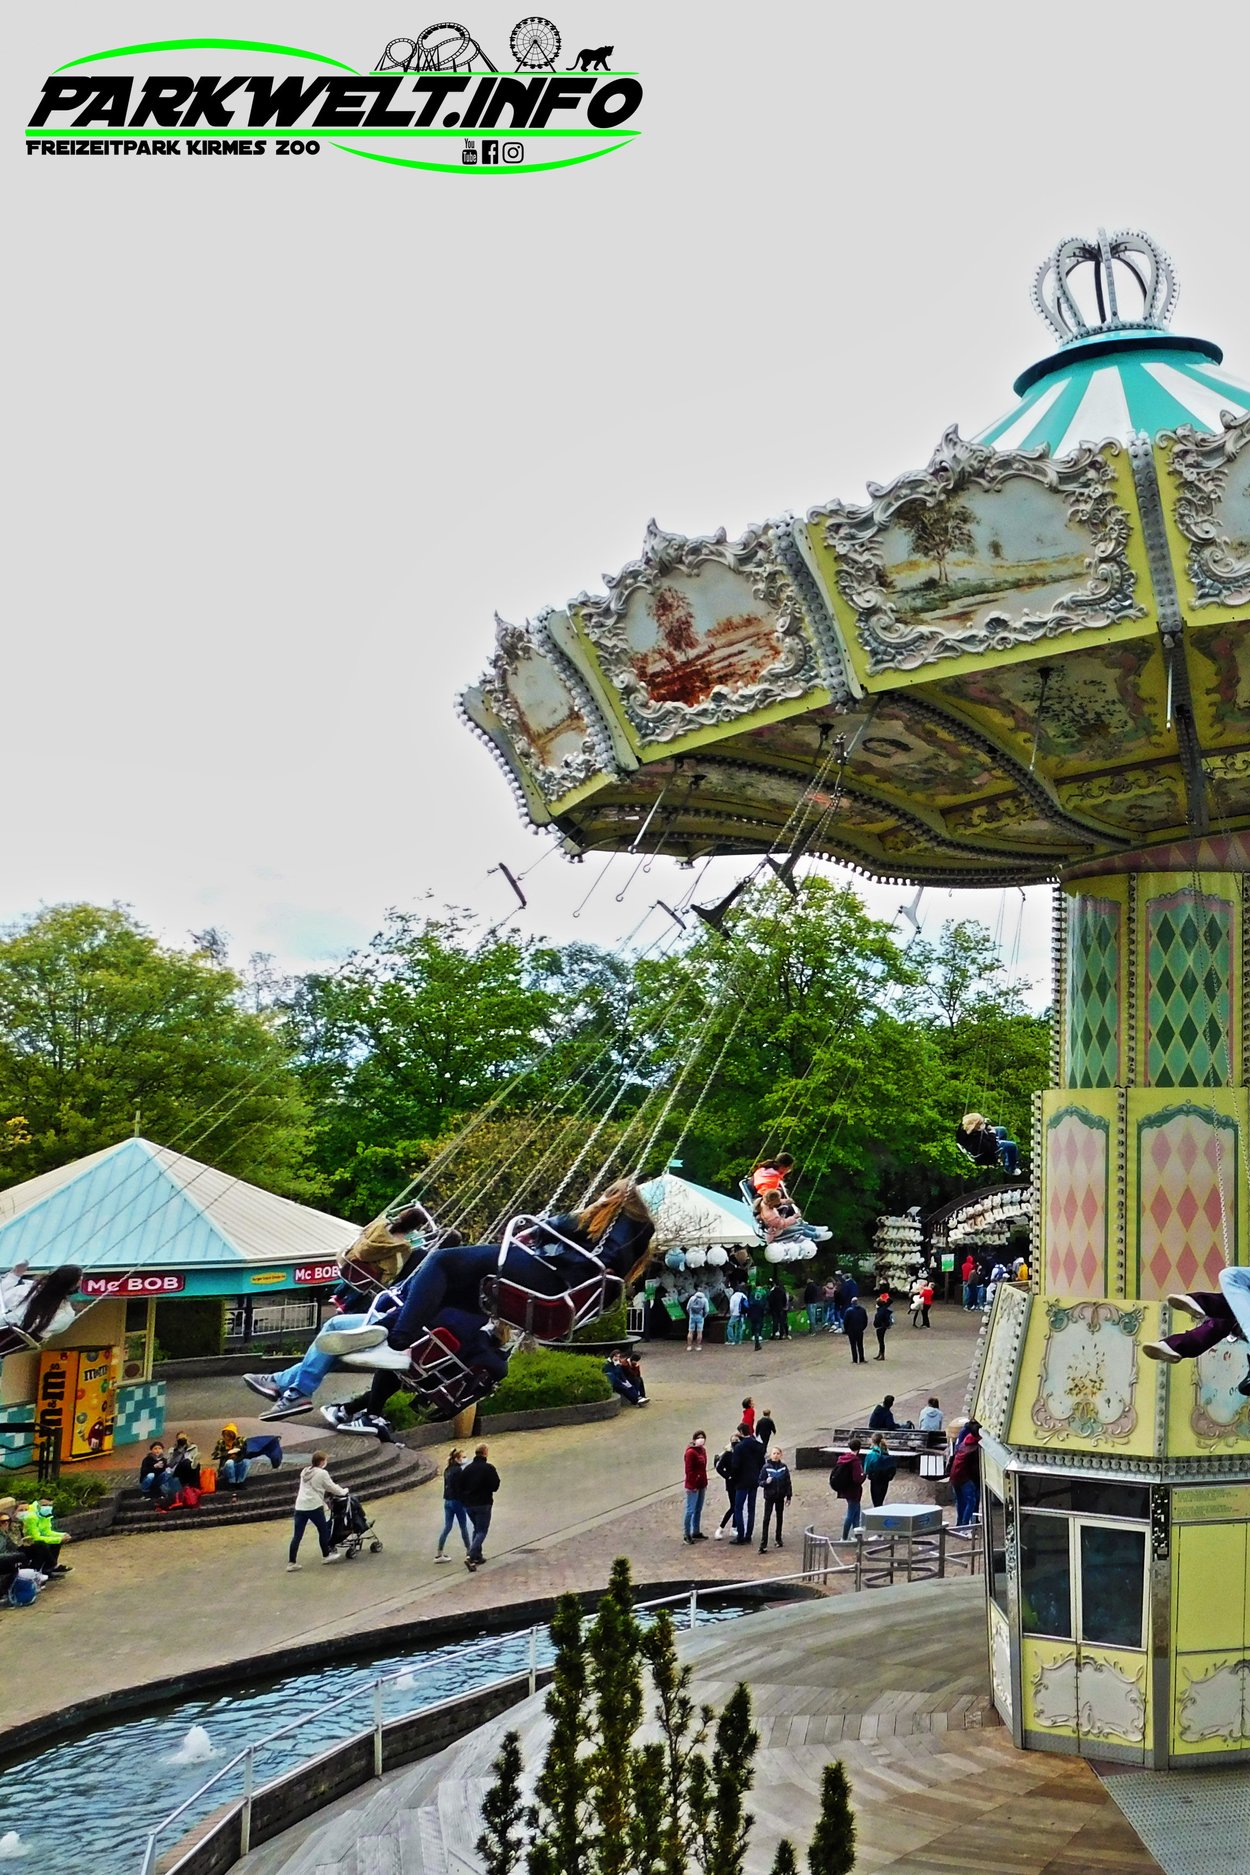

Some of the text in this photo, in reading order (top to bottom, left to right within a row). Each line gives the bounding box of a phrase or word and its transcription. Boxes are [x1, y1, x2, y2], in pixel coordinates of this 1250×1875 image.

[295, 1268, 312, 1281] Mc
[314, 1265, 340, 1280] BOB
[127, 1276, 179, 1291] BOB
